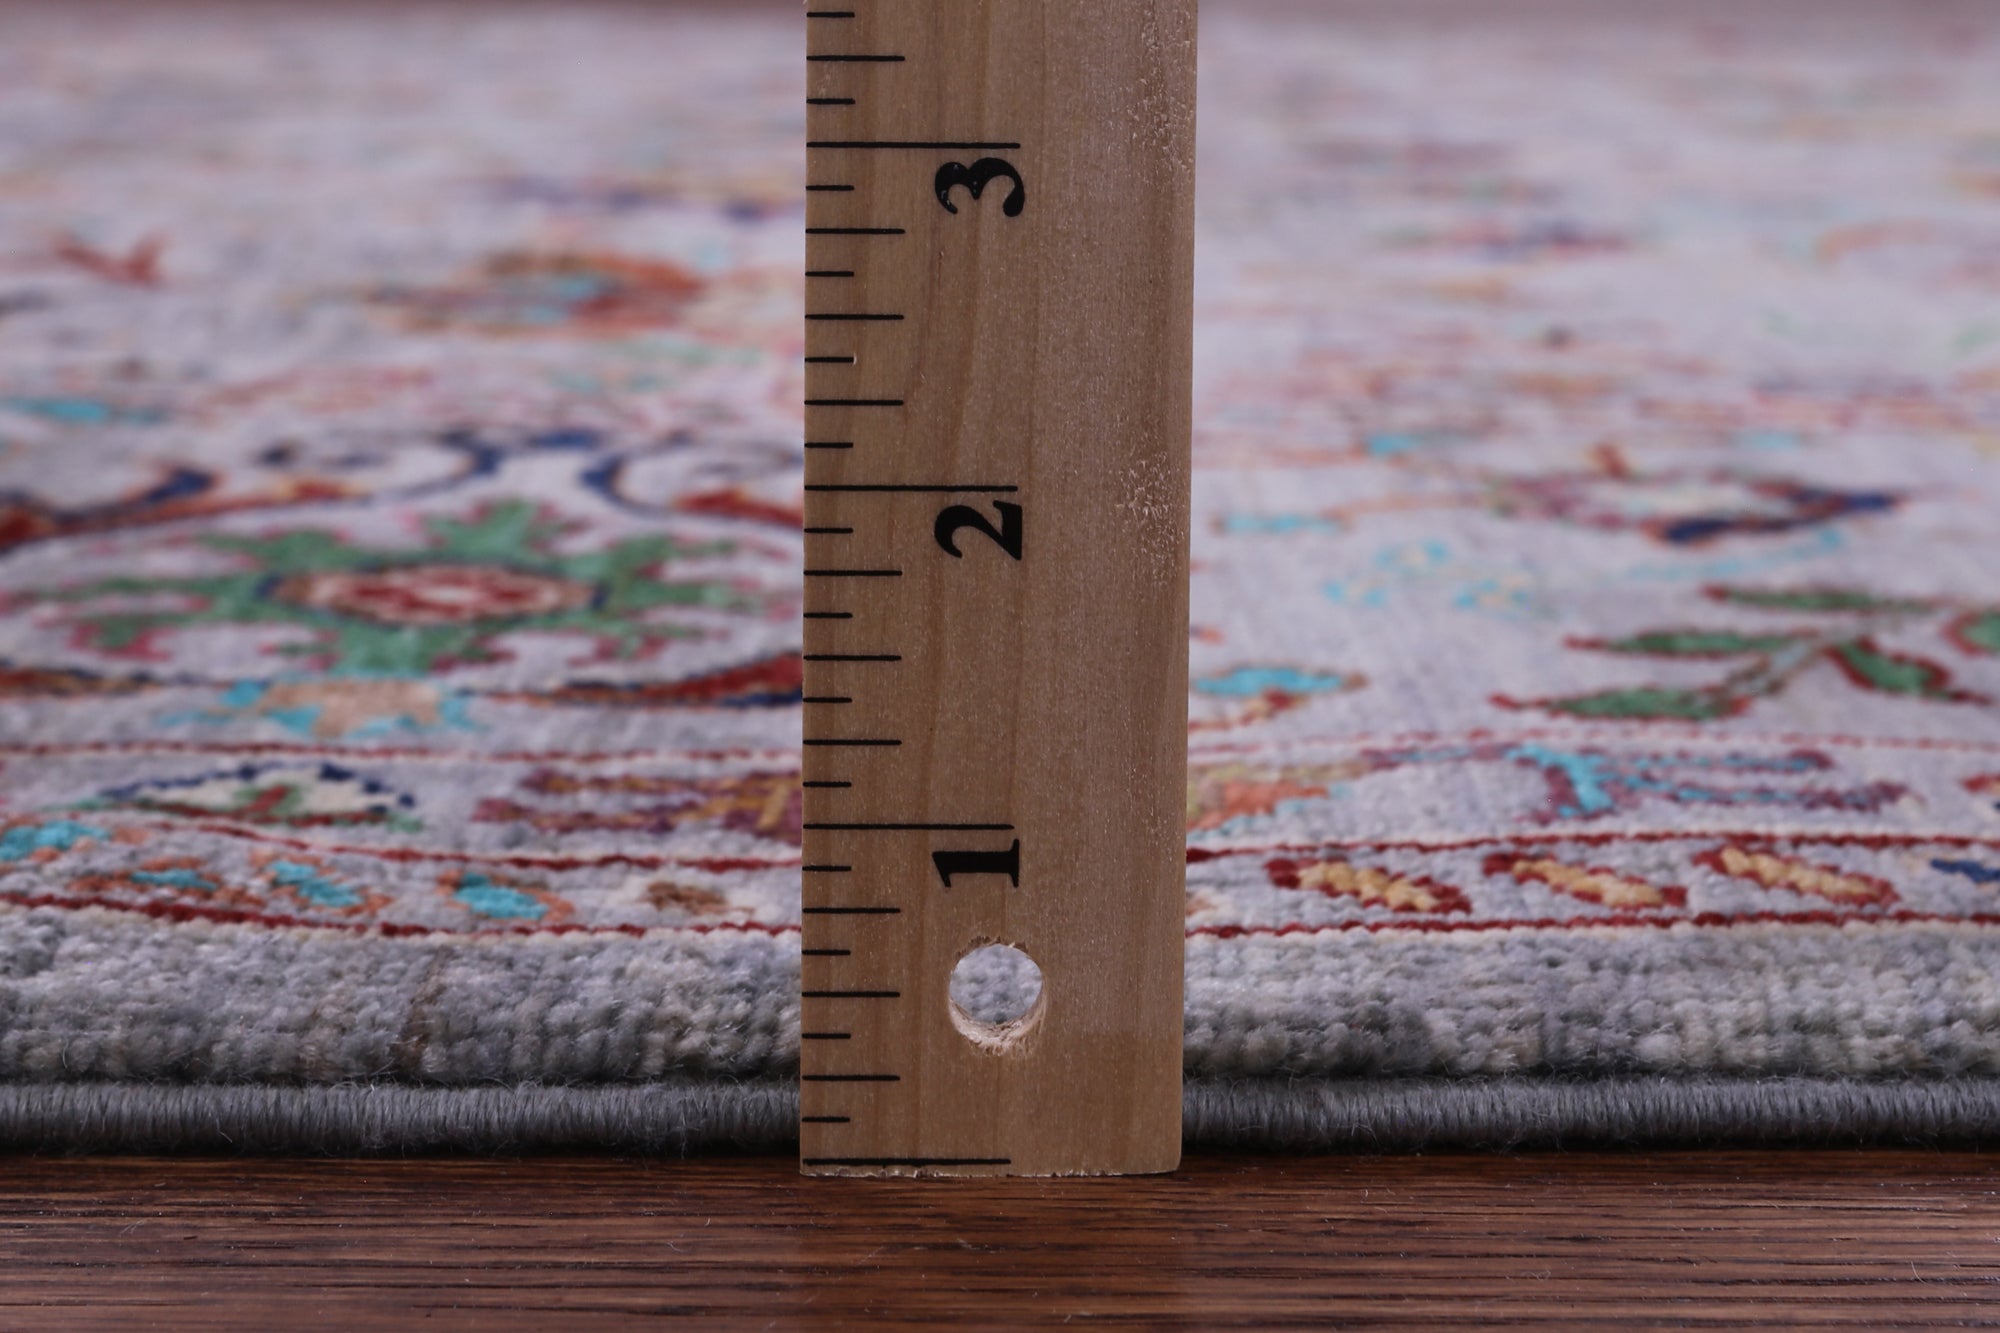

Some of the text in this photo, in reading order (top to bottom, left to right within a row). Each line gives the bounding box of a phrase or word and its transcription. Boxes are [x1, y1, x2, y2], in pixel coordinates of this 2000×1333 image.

[934, 157, 1025, 218] 3
[934, 499, 1023, 561] 2
[932, 838, 1020, 888] 1
